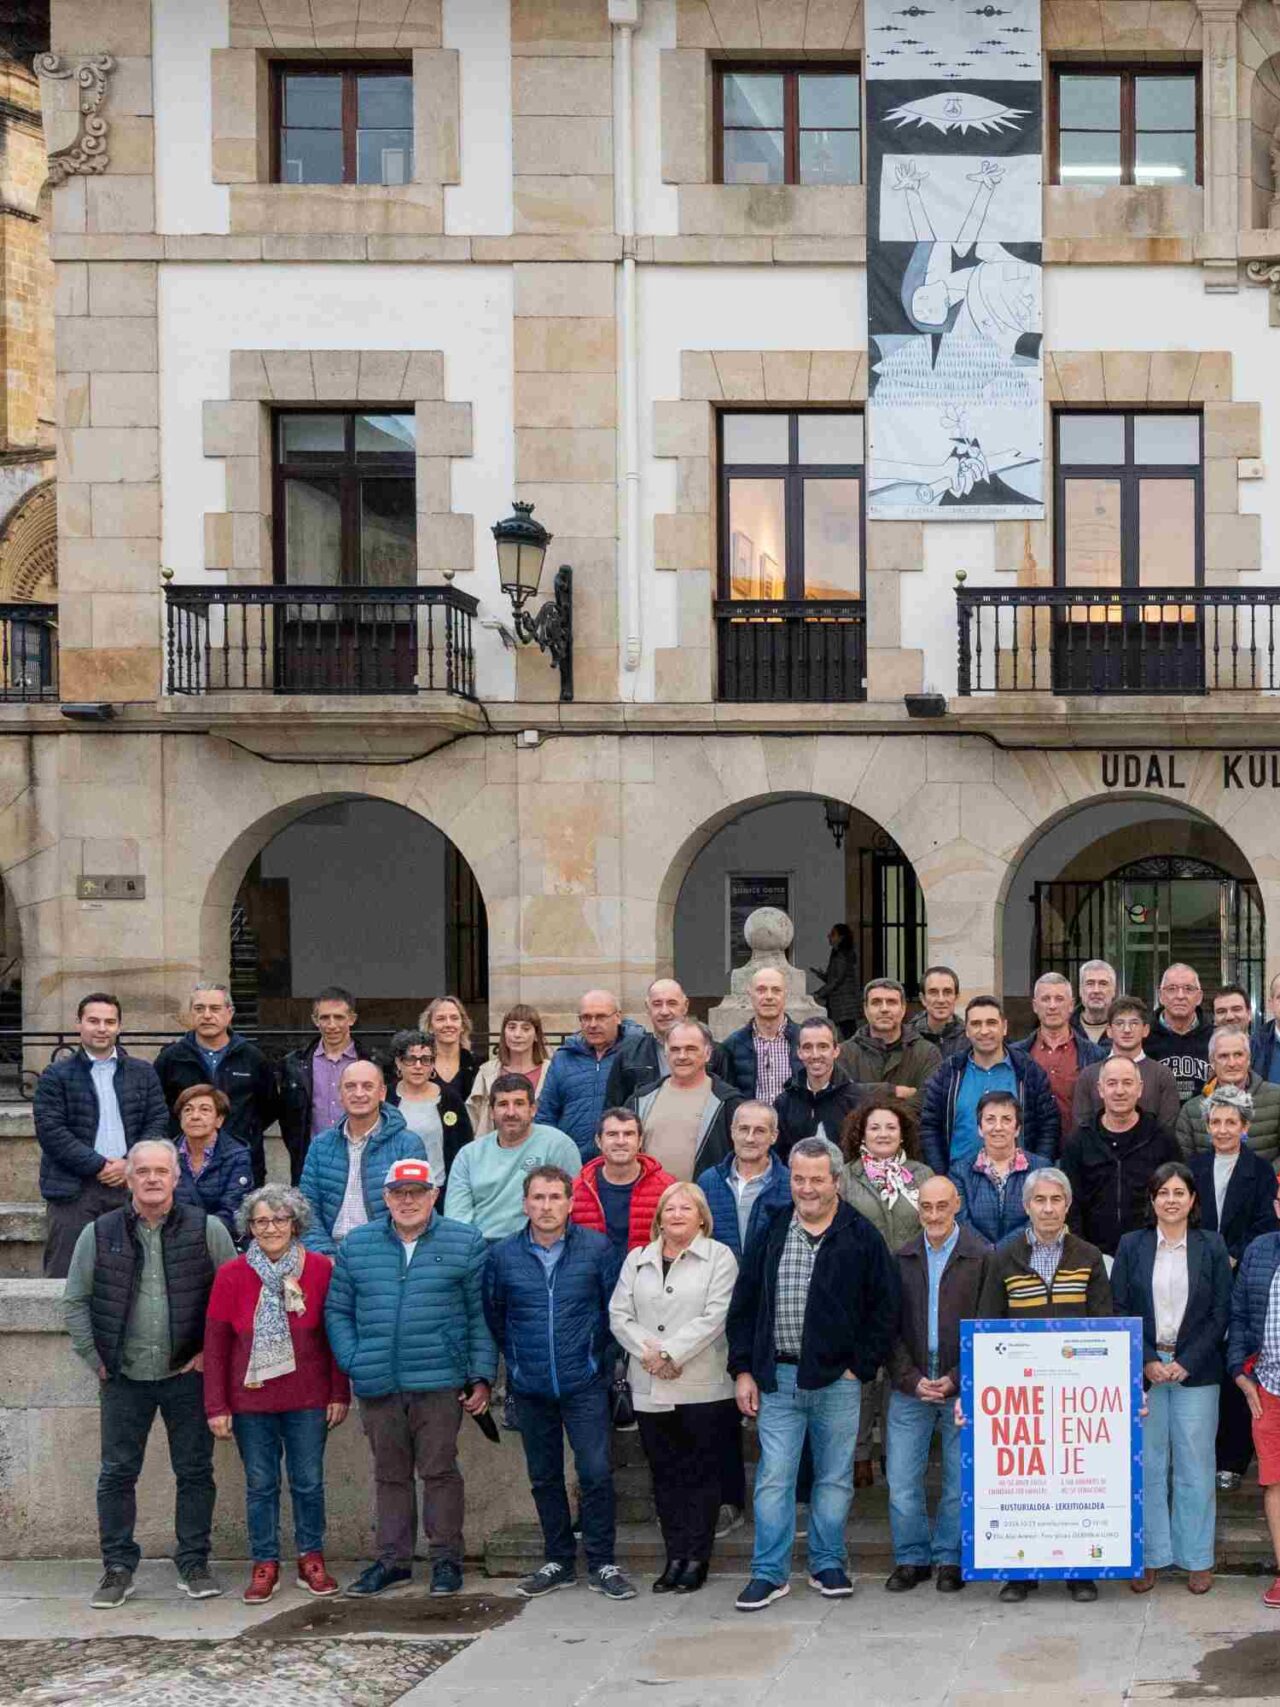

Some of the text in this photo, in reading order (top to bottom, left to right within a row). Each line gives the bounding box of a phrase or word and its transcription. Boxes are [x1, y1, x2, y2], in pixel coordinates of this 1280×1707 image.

[1101, 753, 1185, 788] UDAL
[981, 1386, 1045, 1416] OME
[1062, 1386, 1123, 1413] HOM
[991, 1417, 1046, 1445] NAL
[1062, 1416, 1111, 1444] ENA
[997, 1447, 1046, 1476] DIA
[1060, 1447, 1085, 1475] JE
[1000, 1502, 1105, 1511] BUSTURIALDEA LEKEITIOALDEA
